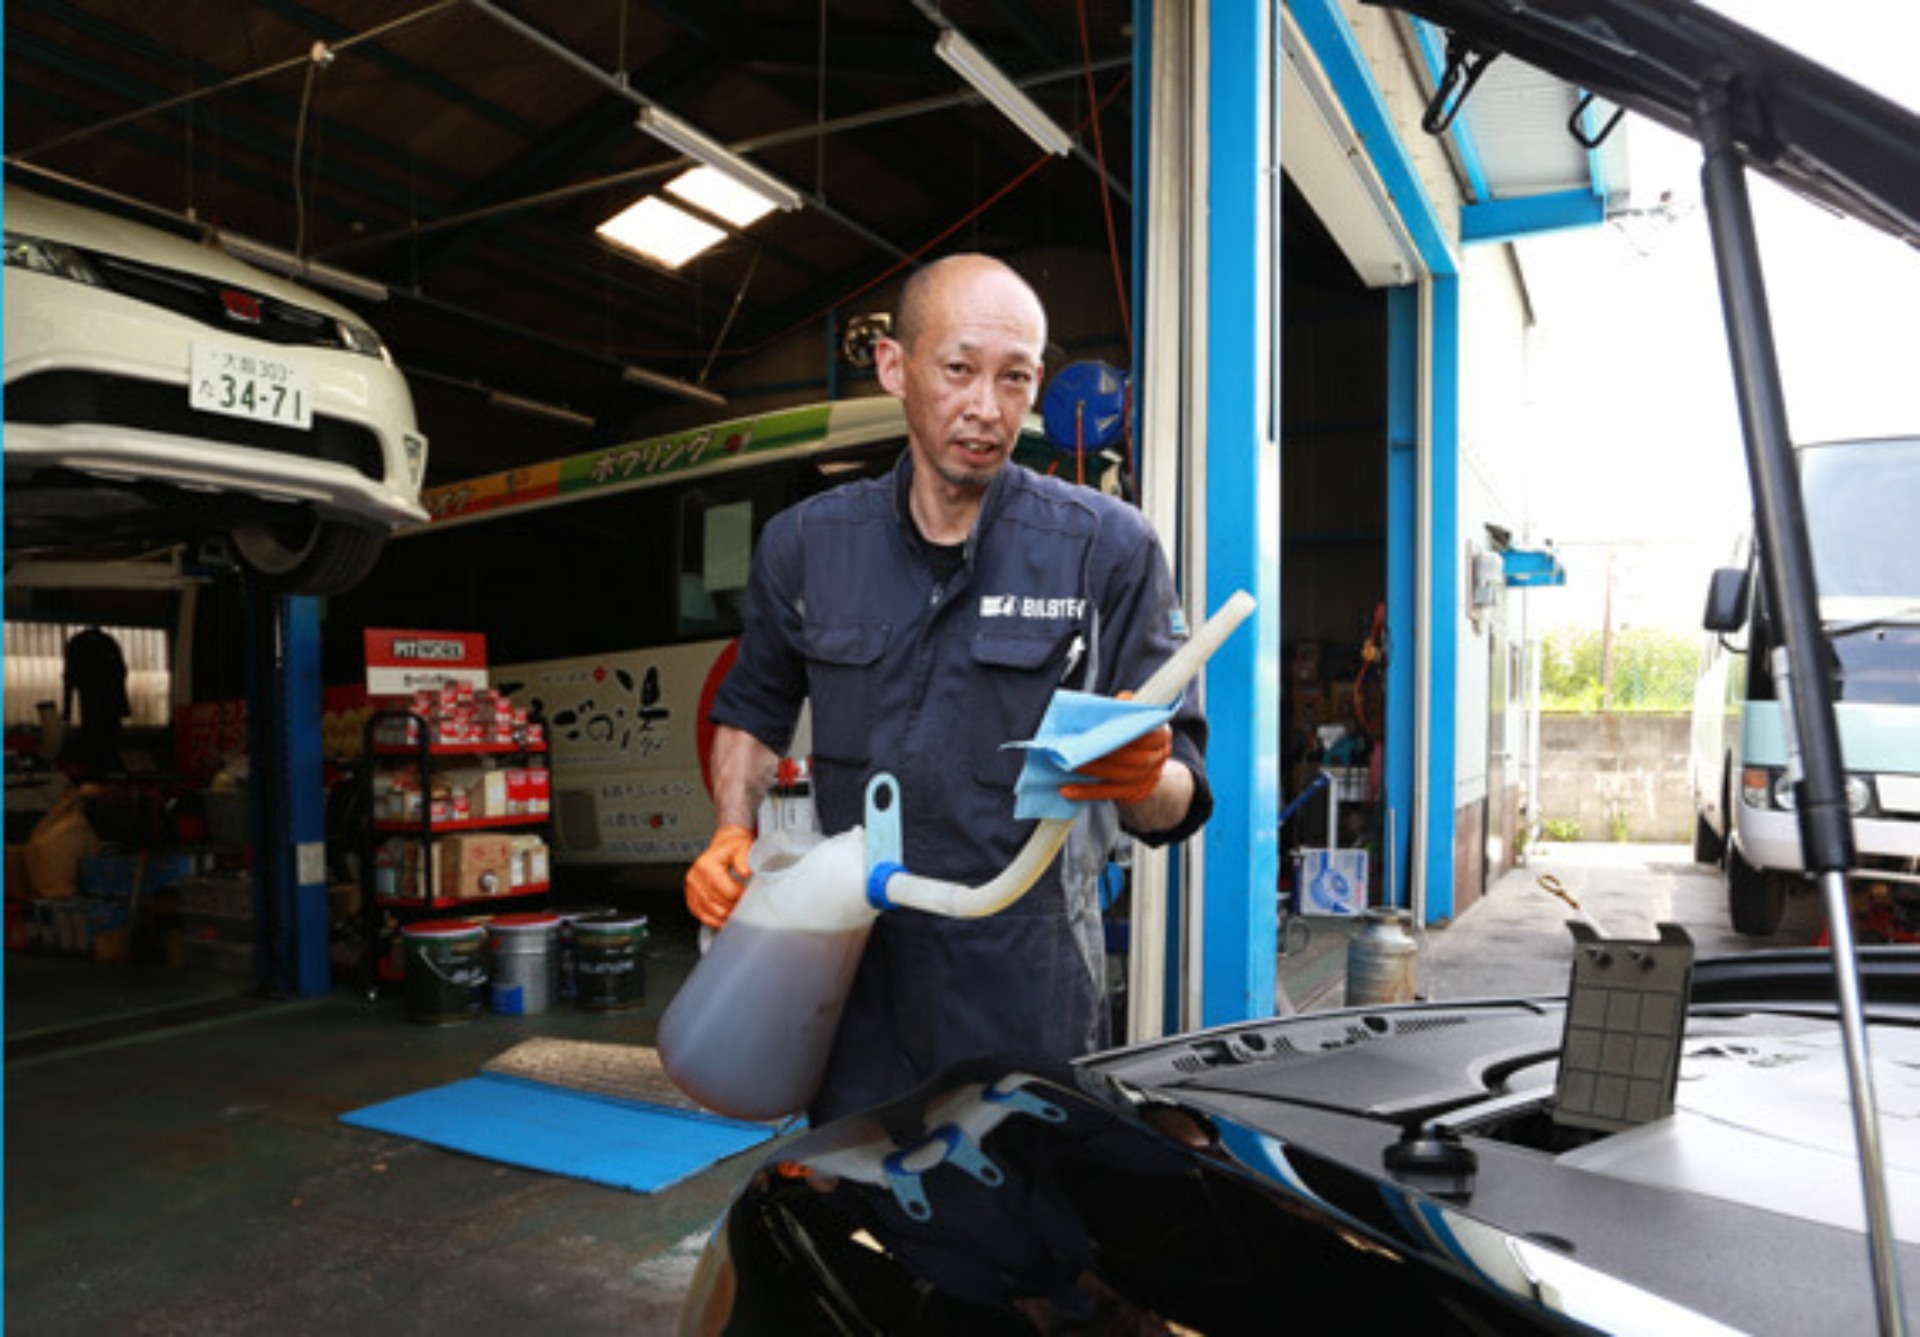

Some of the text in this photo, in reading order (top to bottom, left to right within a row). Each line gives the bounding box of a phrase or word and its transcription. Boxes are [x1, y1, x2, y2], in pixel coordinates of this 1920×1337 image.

[219, 374, 301, 422] 34-71
[592, 430, 714, 483] ボウリング
